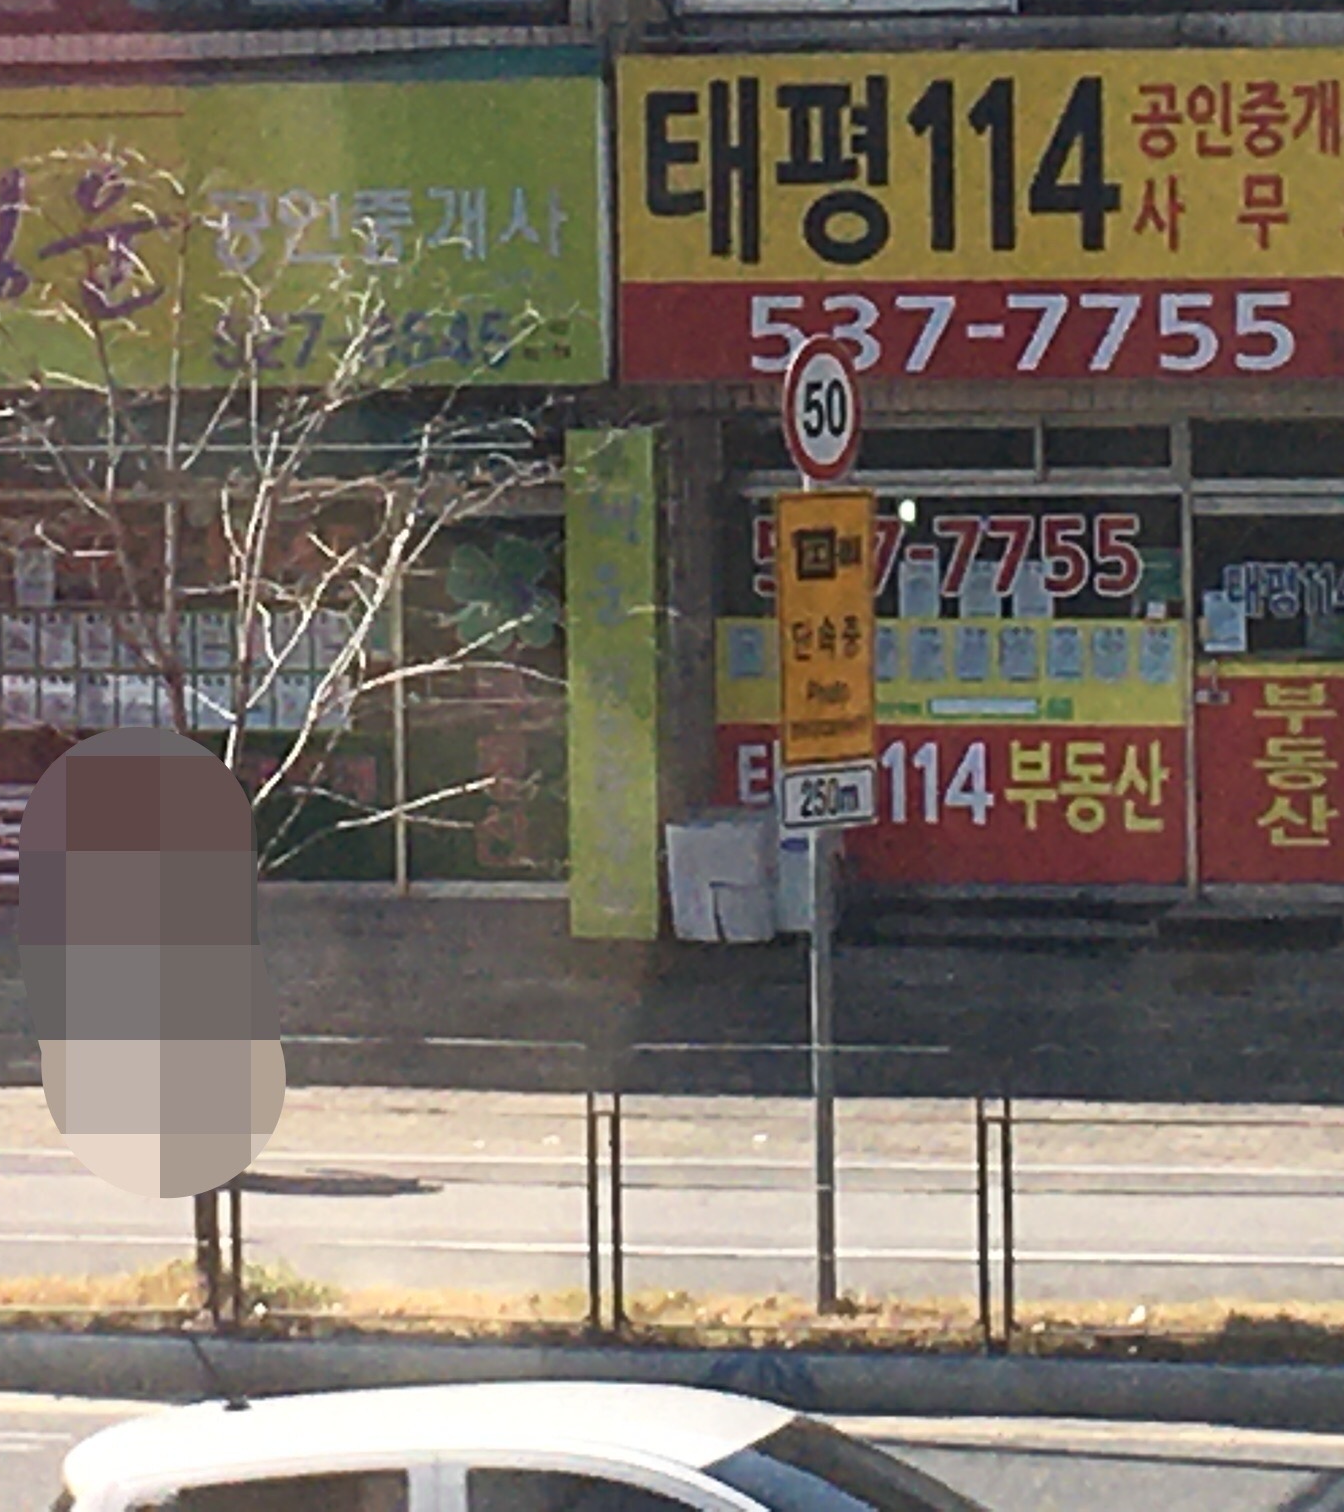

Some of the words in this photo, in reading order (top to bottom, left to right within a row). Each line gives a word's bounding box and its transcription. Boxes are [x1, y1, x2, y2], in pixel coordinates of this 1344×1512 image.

[645, 75, 1121, 265] 태평114
[209, 188, 568, 268] 공인중개사
[750, 290, 1296, 373] 537-7755
[802, 378, 847, 439] 50
[753, 513, 1141, 600] 57-7755
[801, 777, 860, 819] 250m
[1005, 739, 1169, 833] 부동산
[1254, 681, 1338, 849] 부동산
